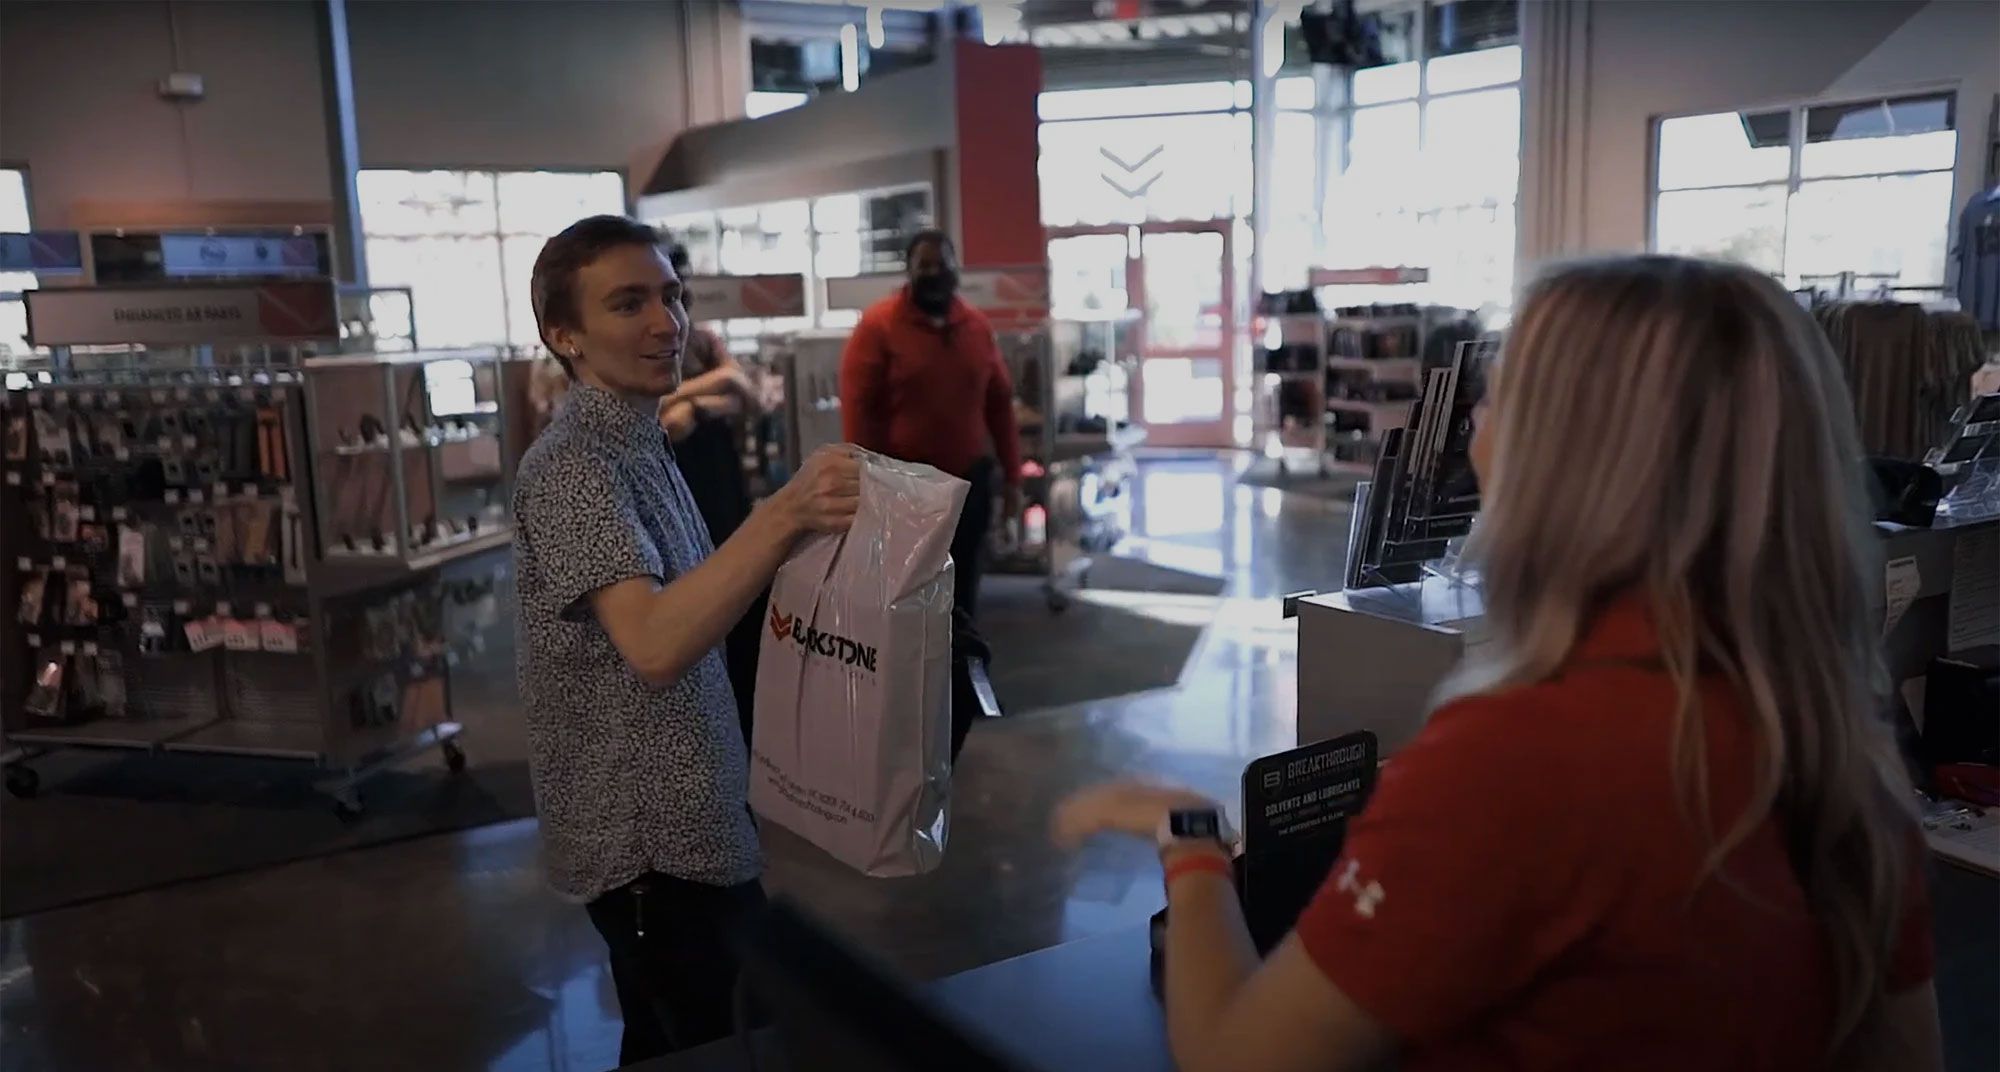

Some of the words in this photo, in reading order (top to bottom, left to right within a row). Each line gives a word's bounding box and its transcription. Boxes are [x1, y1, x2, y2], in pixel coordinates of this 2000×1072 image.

[792, 617, 877, 672] BLCKSTONE
[1287, 742, 1366, 779] BREAKTHROUGH
[1265, 797, 1301, 817] SOLVENTS
[1302, 790, 1317, 805] AND
[1318, 778, 1361, 800] LUBRICANTS
